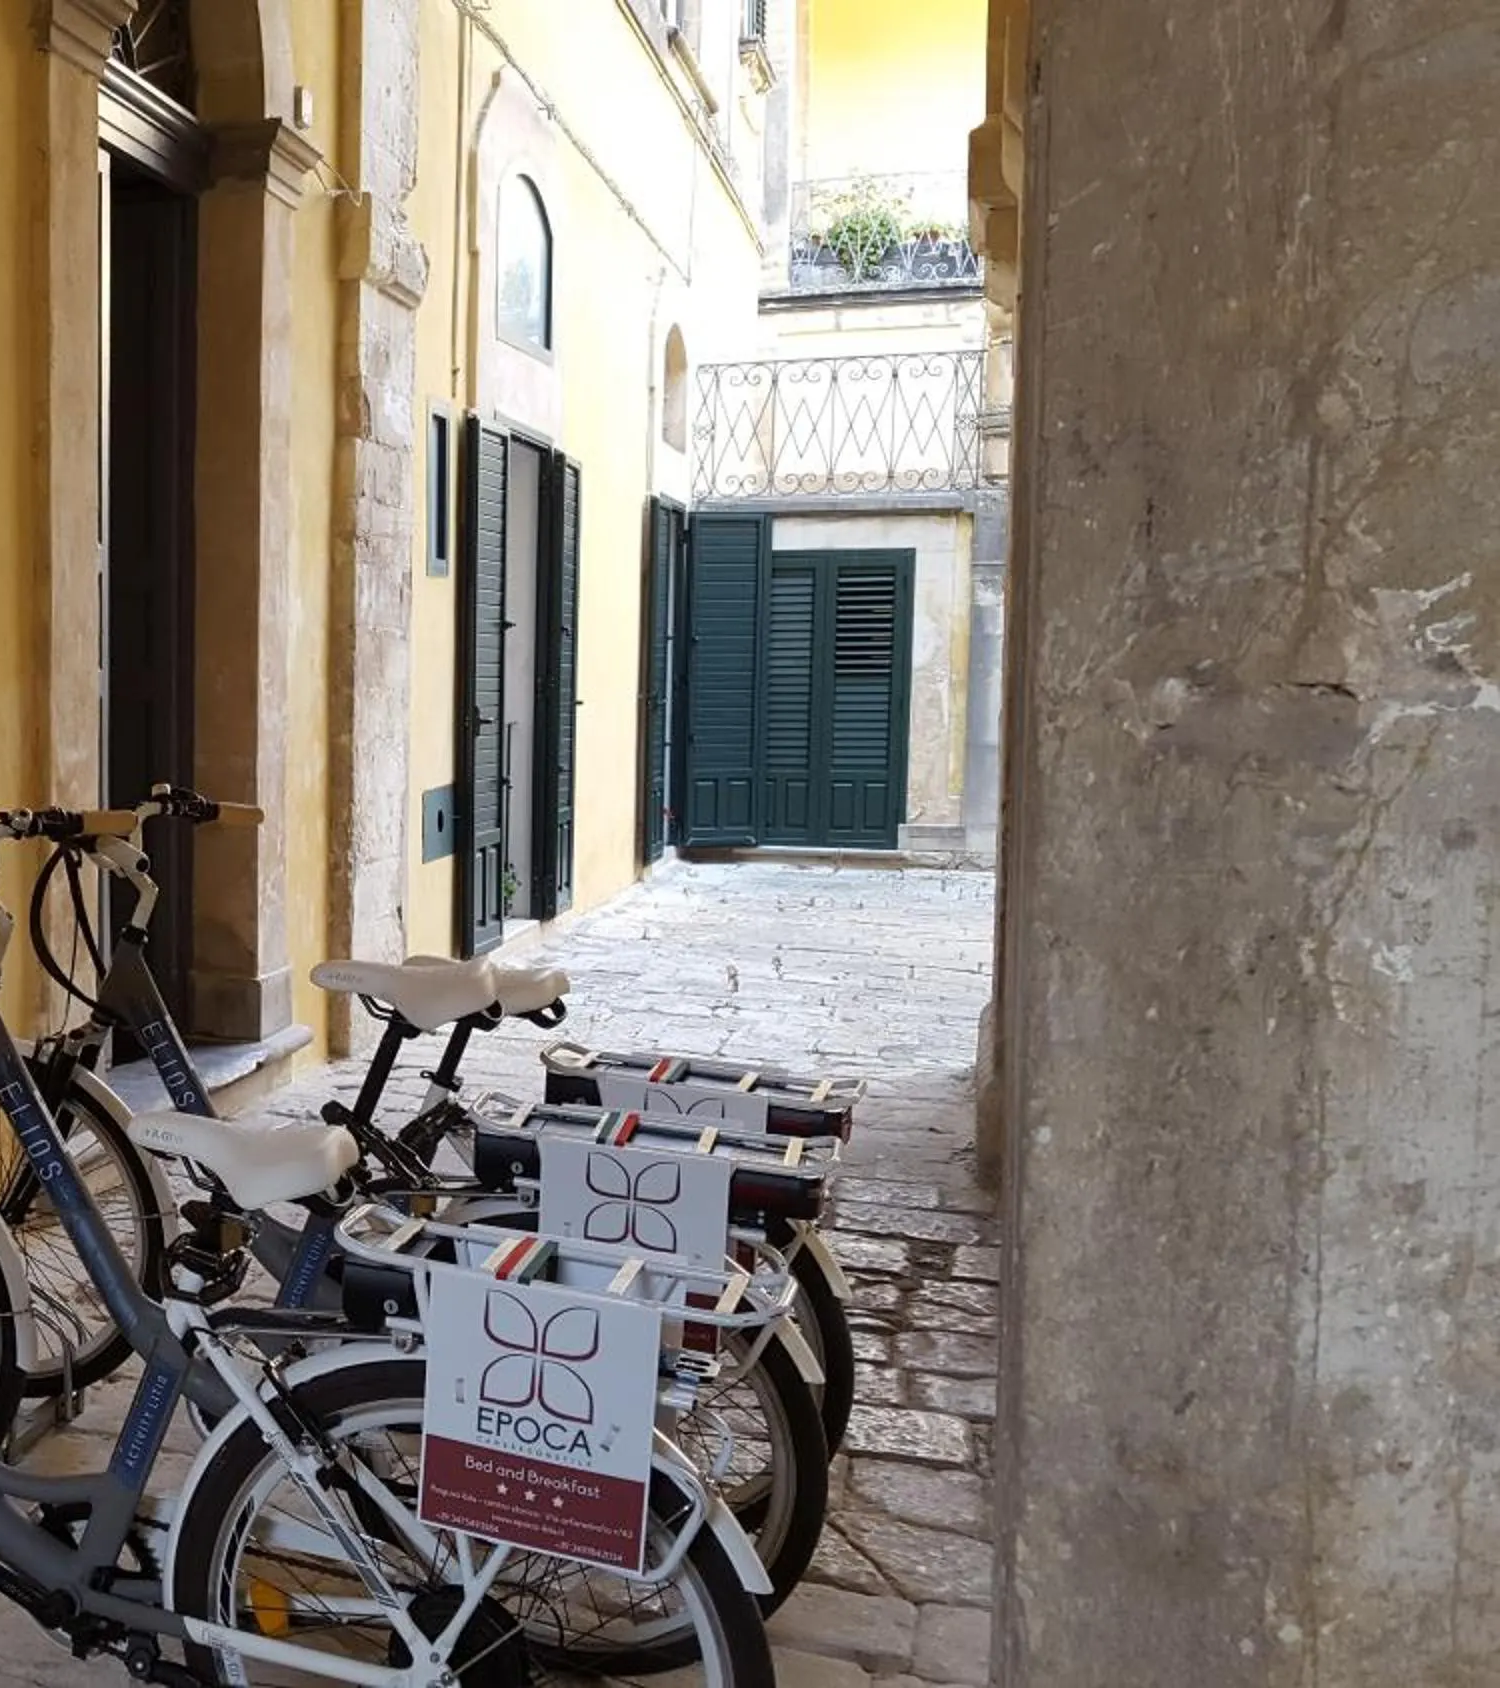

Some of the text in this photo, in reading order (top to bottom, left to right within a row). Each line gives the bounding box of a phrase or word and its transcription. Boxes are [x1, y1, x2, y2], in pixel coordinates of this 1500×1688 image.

[141, 1020, 195, 1107] ELIOS
[476, 1405, 592, 1457] EPOCA
[464, 1454, 601, 1499] Bed and Breakfast
